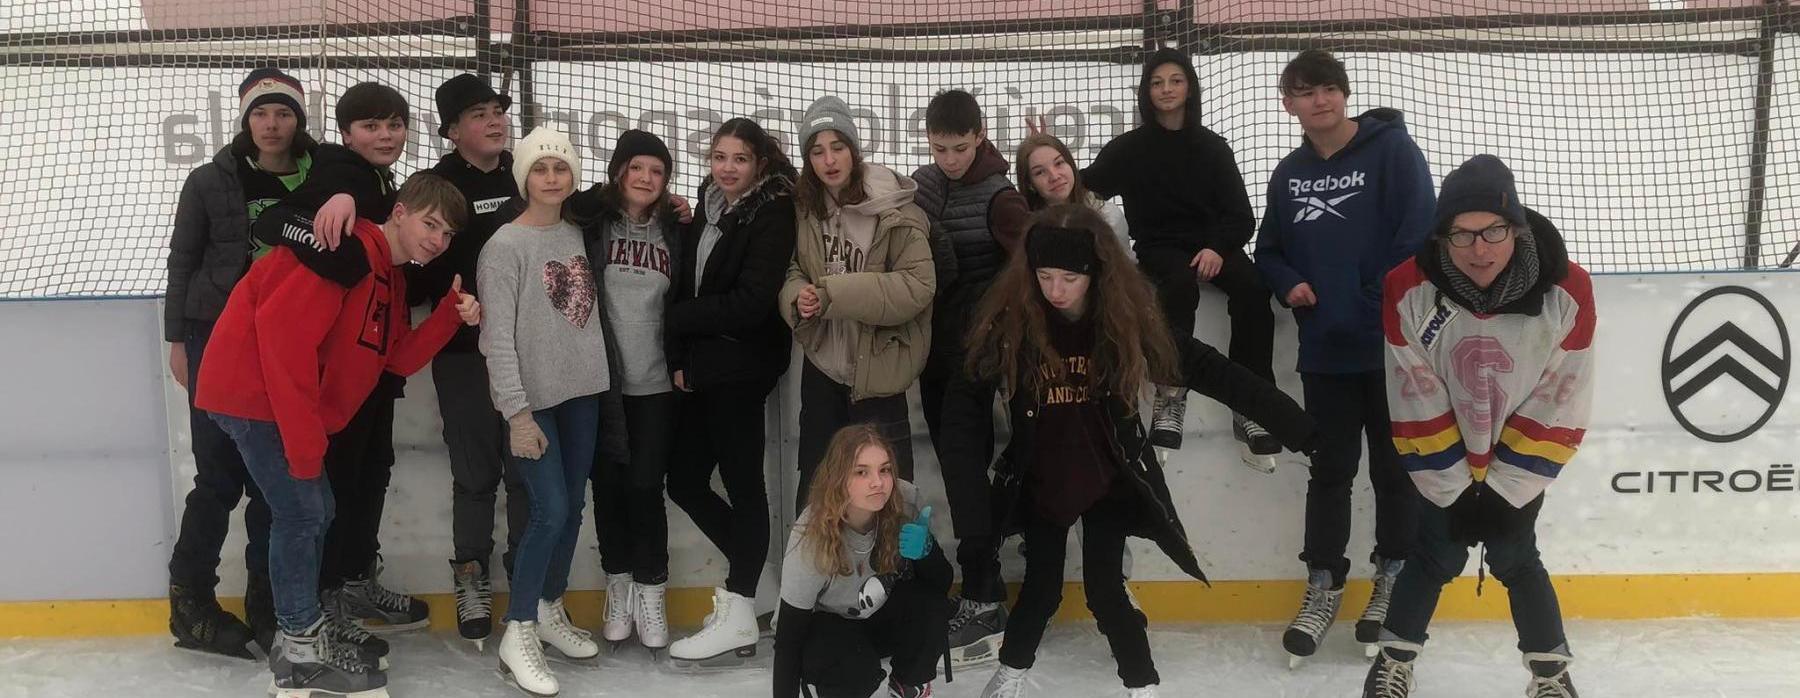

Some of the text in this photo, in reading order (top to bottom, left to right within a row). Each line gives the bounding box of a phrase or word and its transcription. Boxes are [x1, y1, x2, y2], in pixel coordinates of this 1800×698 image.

[1288, 170, 1366, 197] Reebok
[1046, 386, 1074, 404] AND
[1611, 463, 1800, 494] CITROË
